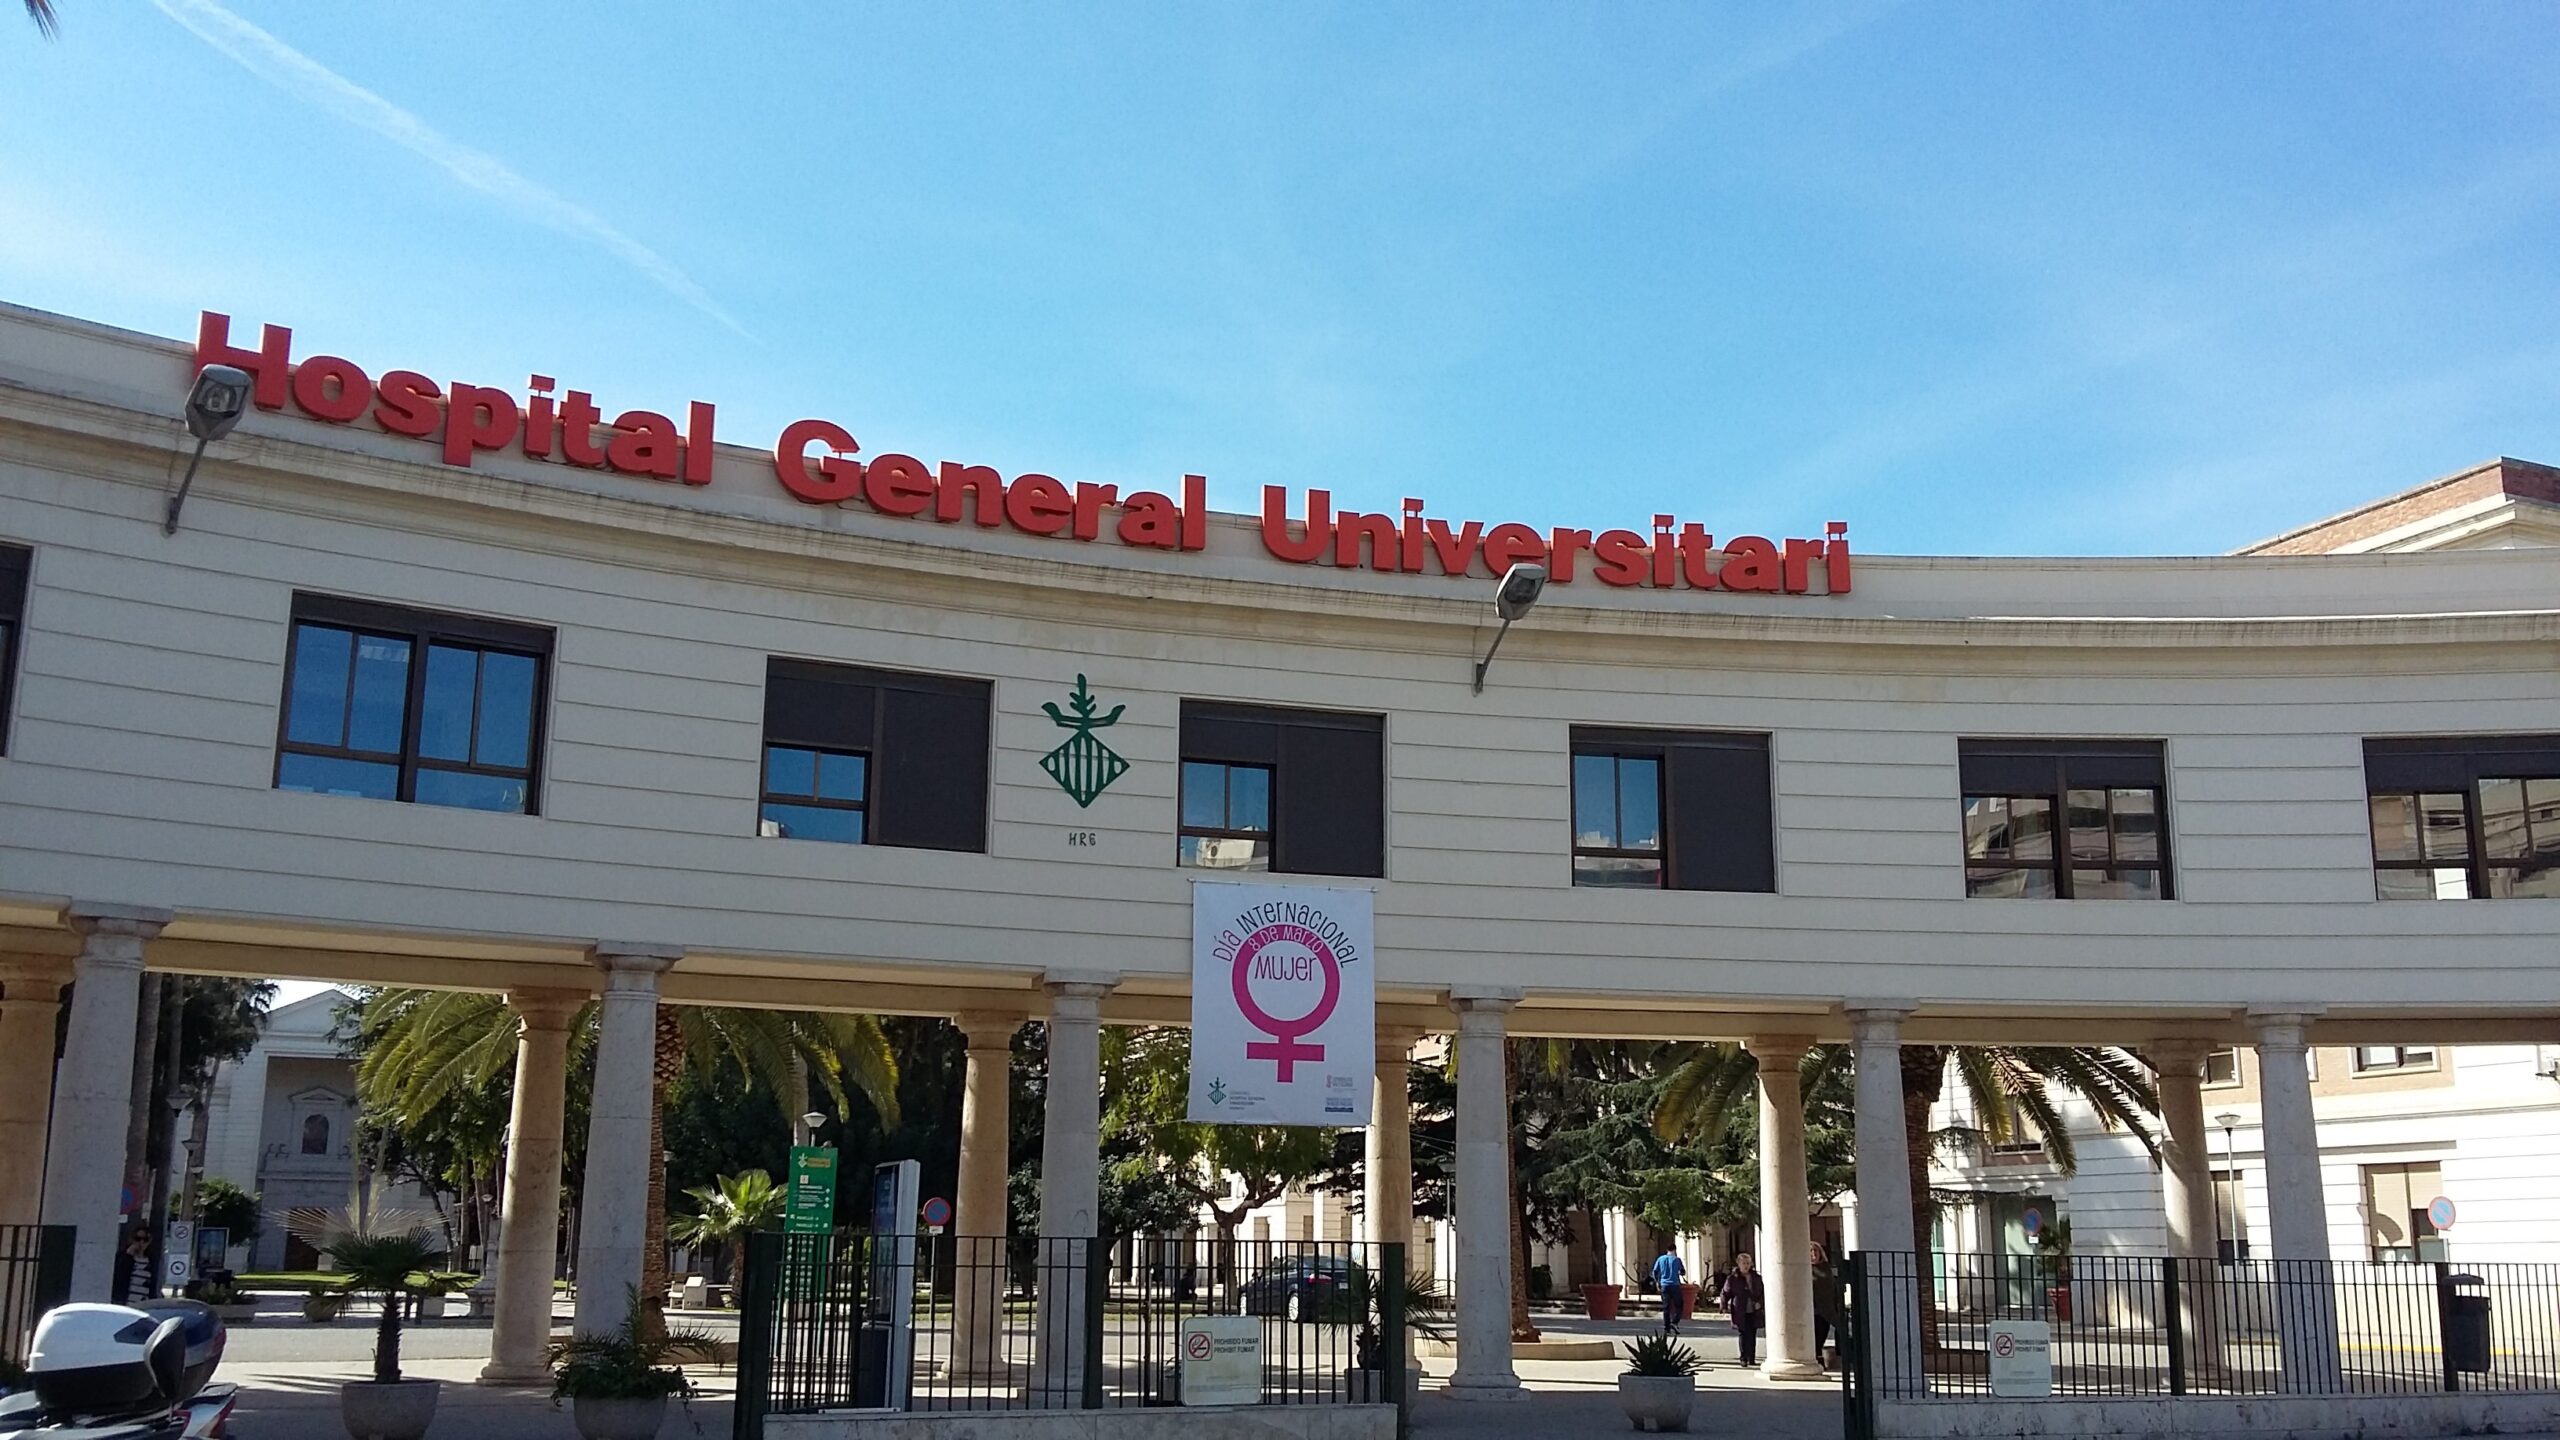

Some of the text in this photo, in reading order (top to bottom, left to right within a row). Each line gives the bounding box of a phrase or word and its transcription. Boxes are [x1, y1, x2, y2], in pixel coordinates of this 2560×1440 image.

[195, 311, 1852, 594] Hospital General Universitari
[1249, 938, 1261, 952] 8
